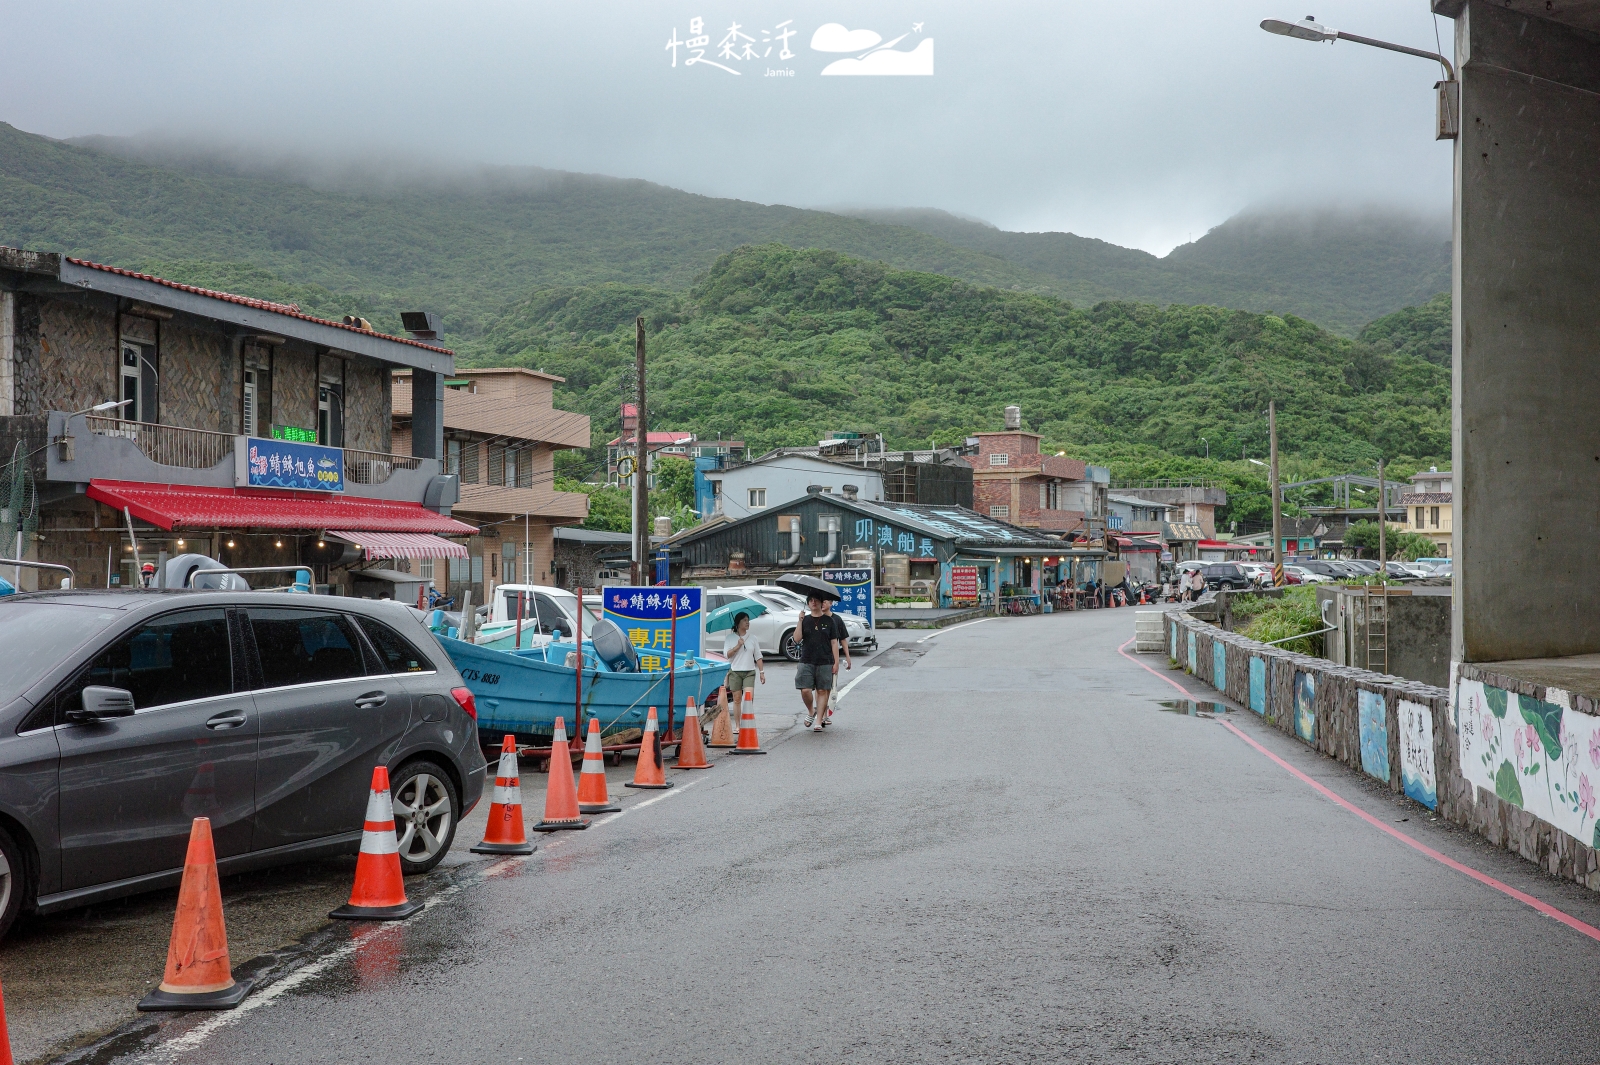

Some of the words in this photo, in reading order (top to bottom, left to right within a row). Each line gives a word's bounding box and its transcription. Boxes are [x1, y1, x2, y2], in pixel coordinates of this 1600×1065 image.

[855, 518, 935, 557] 卯澳船長
[627, 627, 673, 649] 專用
